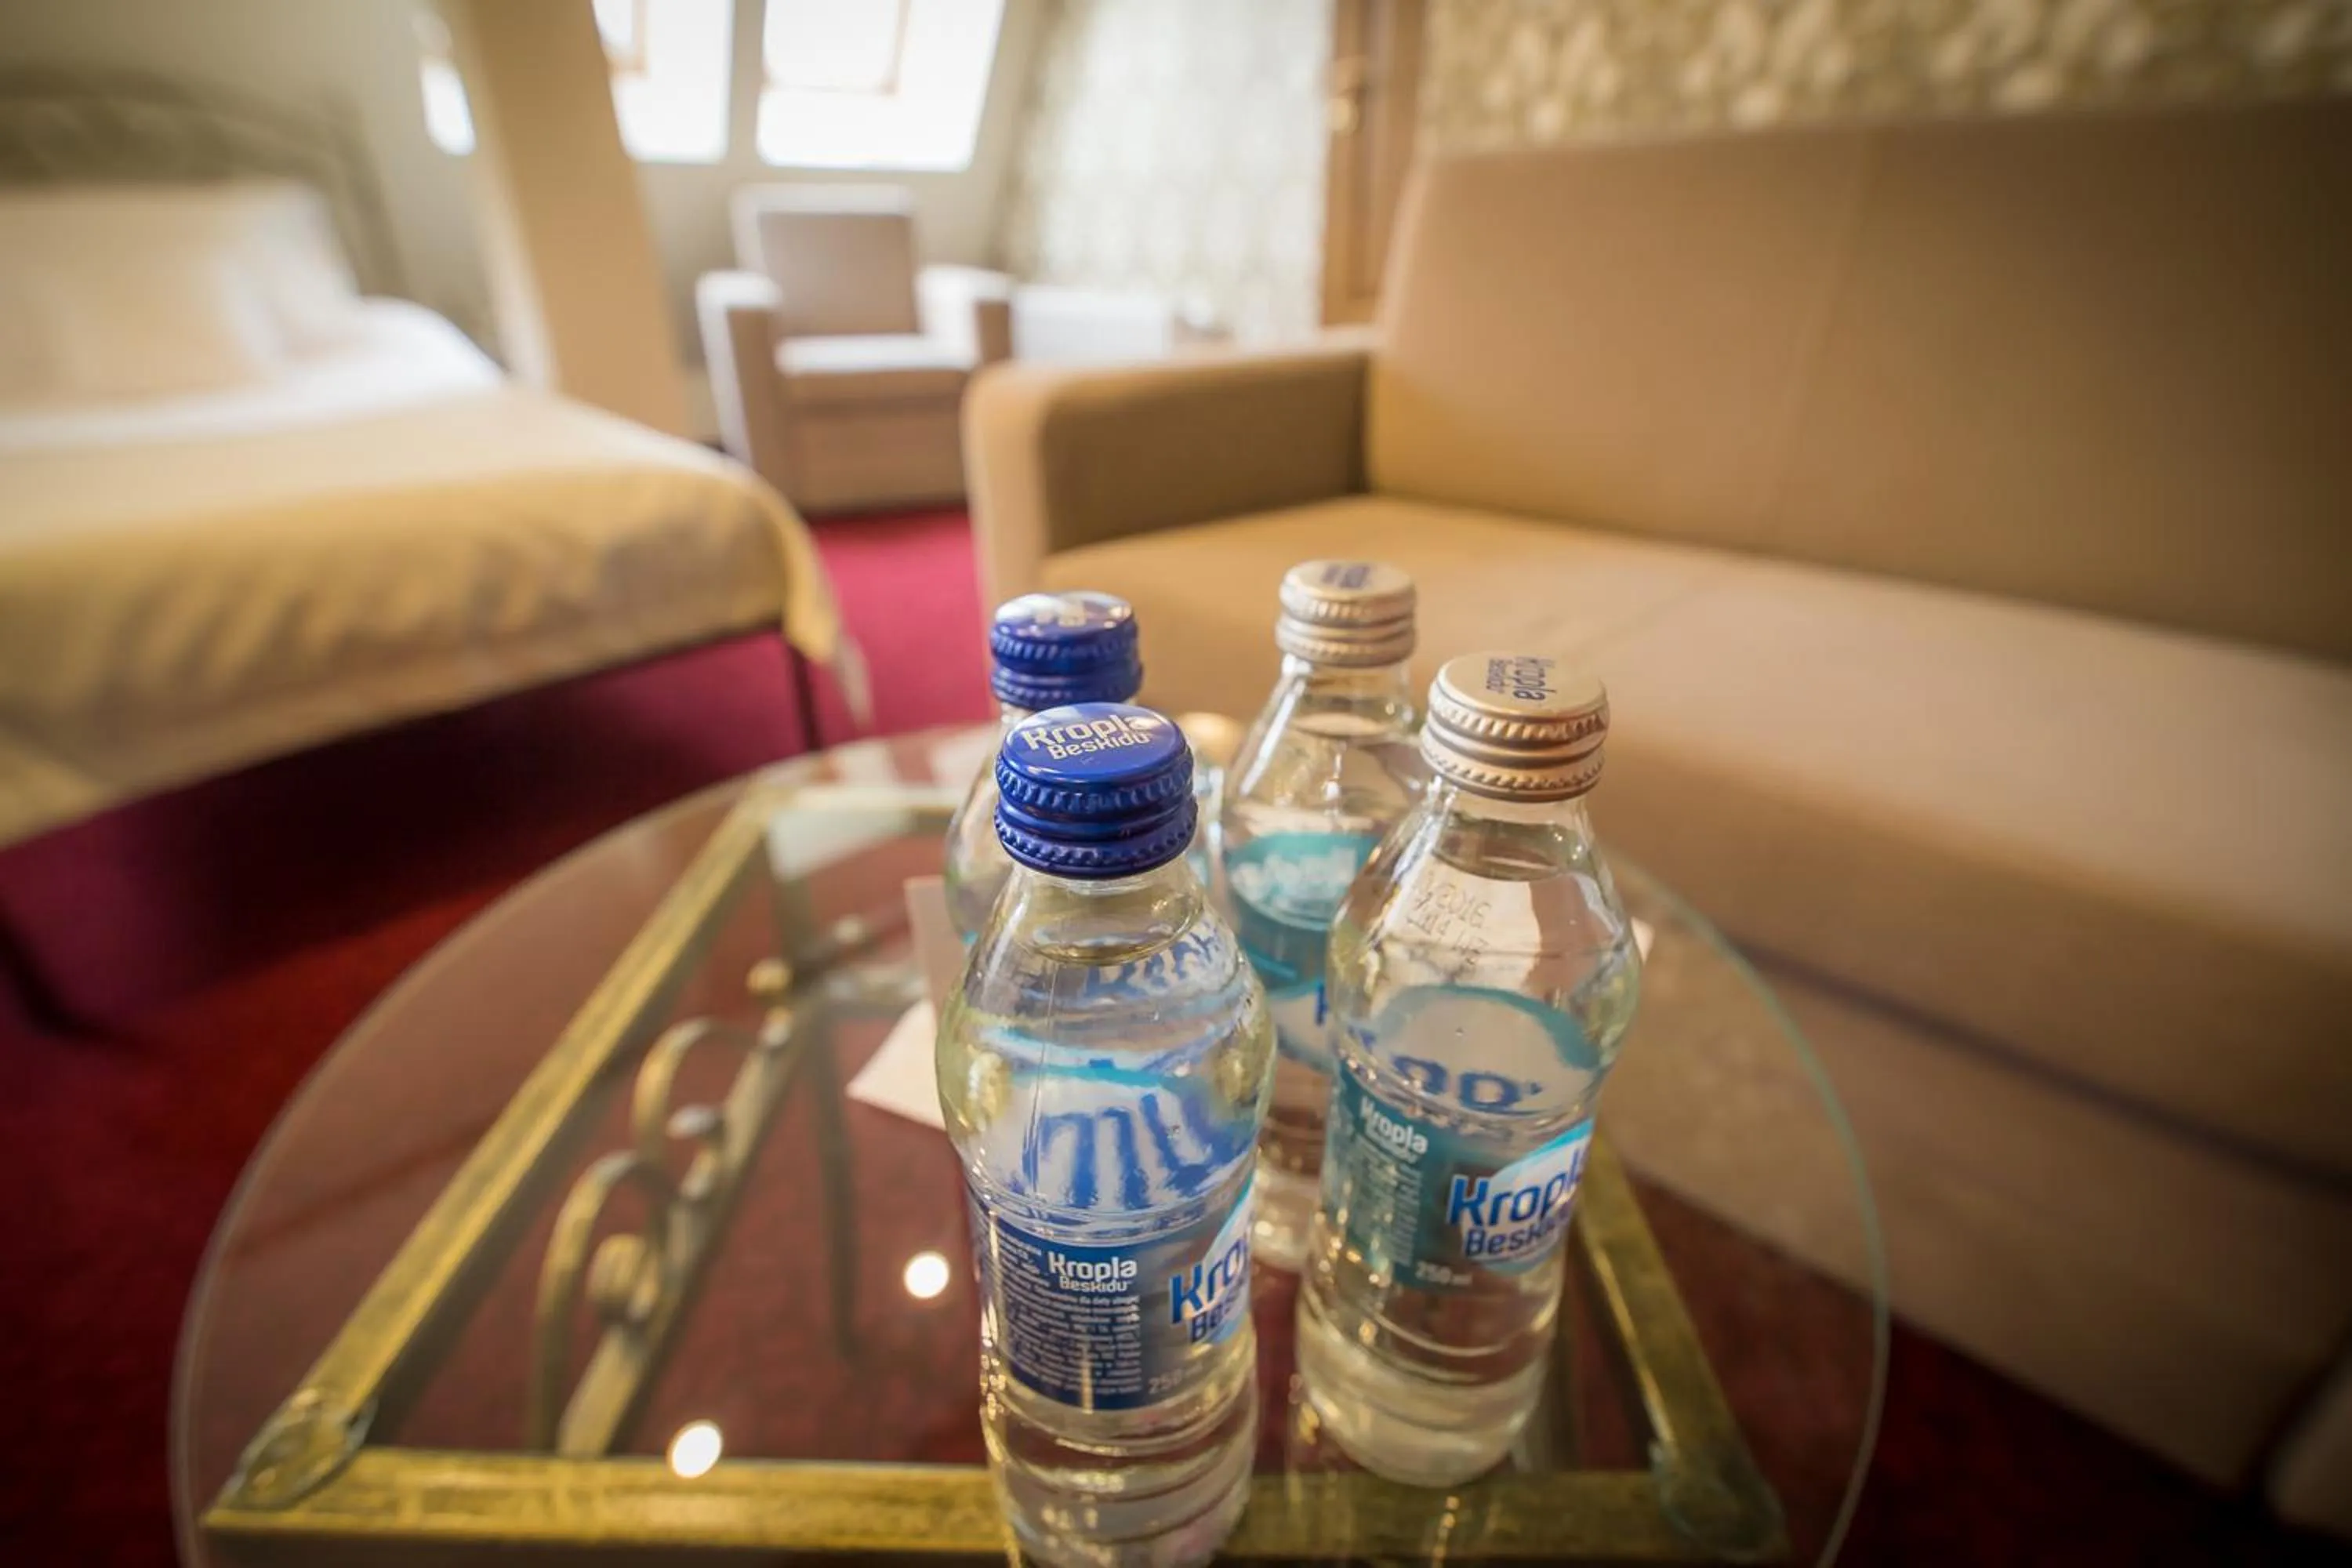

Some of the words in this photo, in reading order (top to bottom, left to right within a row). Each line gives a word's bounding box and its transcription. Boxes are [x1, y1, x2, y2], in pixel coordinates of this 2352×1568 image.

[1047, 731, 1149, 760] Beskidu
[1447, 1149, 1583, 1228] Kropl
[1047, 1251, 1138, 1283] Kropla
[1059, 1276, 1128, 1293] Beskidu
